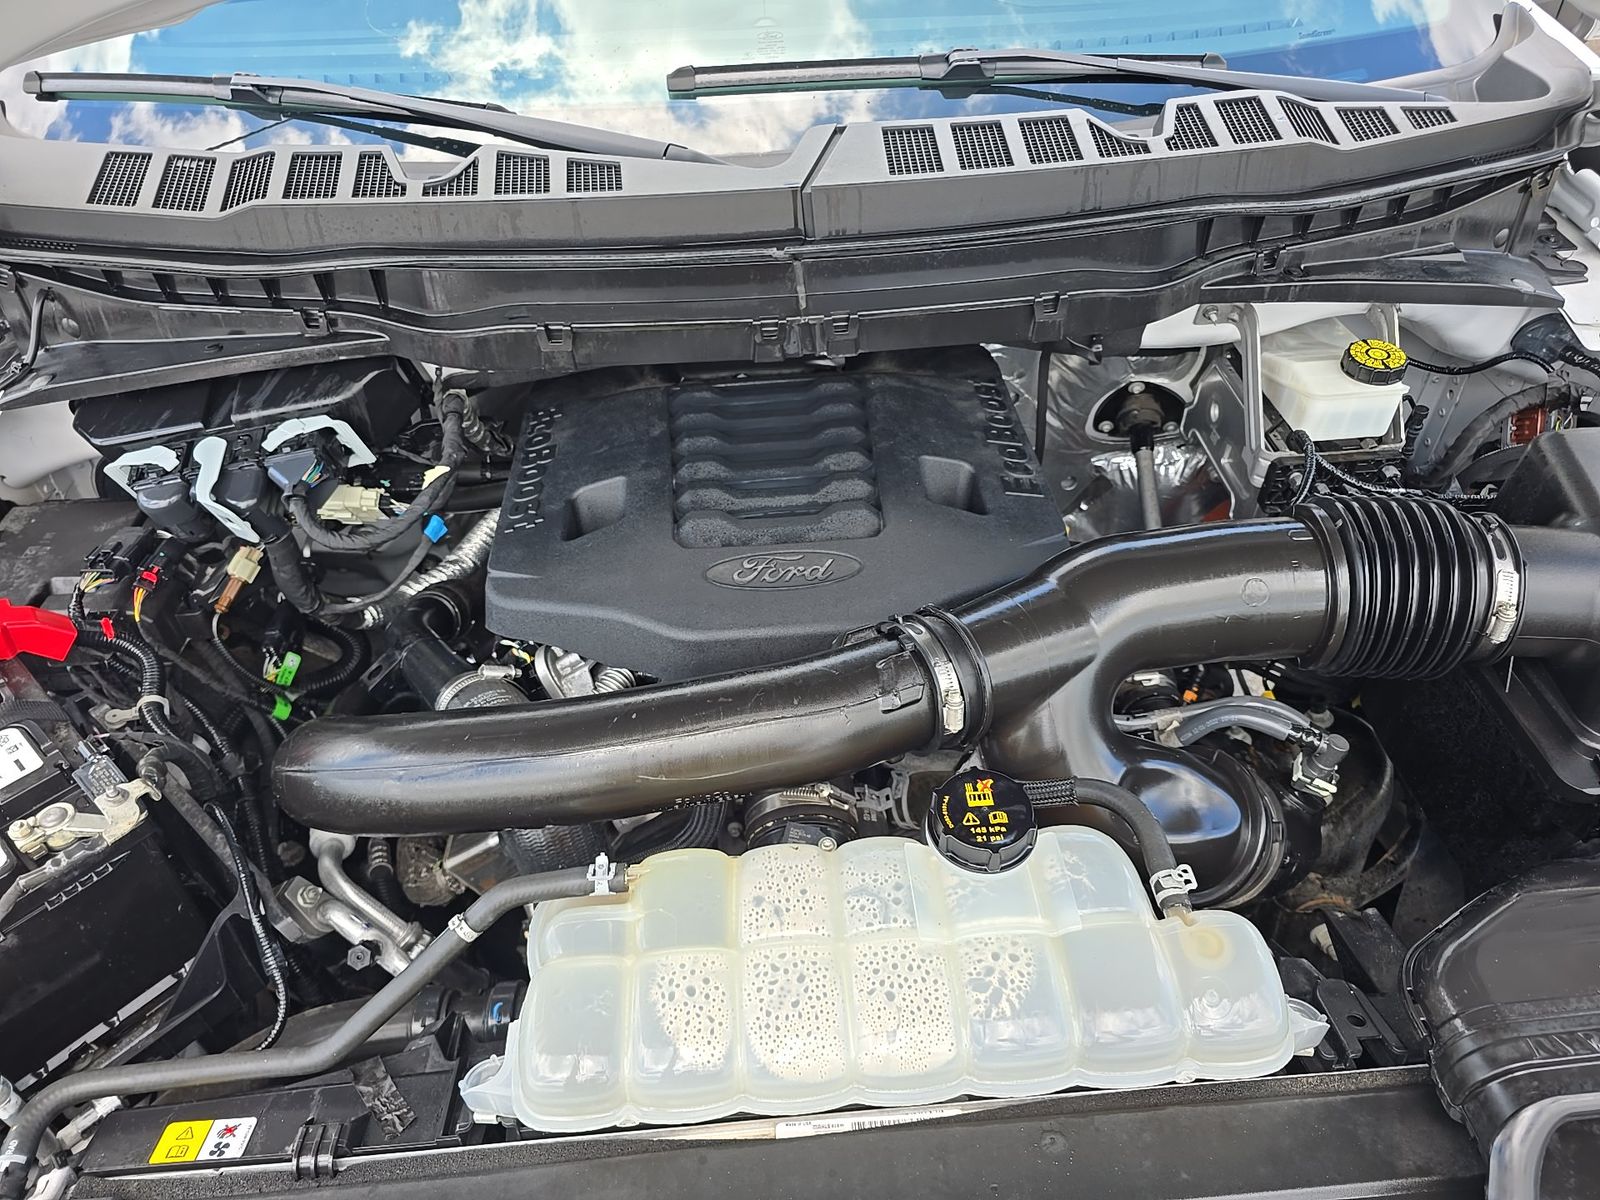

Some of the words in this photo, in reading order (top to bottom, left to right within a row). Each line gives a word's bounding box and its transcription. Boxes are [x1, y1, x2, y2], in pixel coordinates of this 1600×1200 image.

[967, 379, 1045, 497] EcoBoost
[732, 554, 834, 585] Ford
[976, 835, 988, 843] 21
[990, 834, 1004, 842] psi
[989, 825, 1007, 833] kPa
